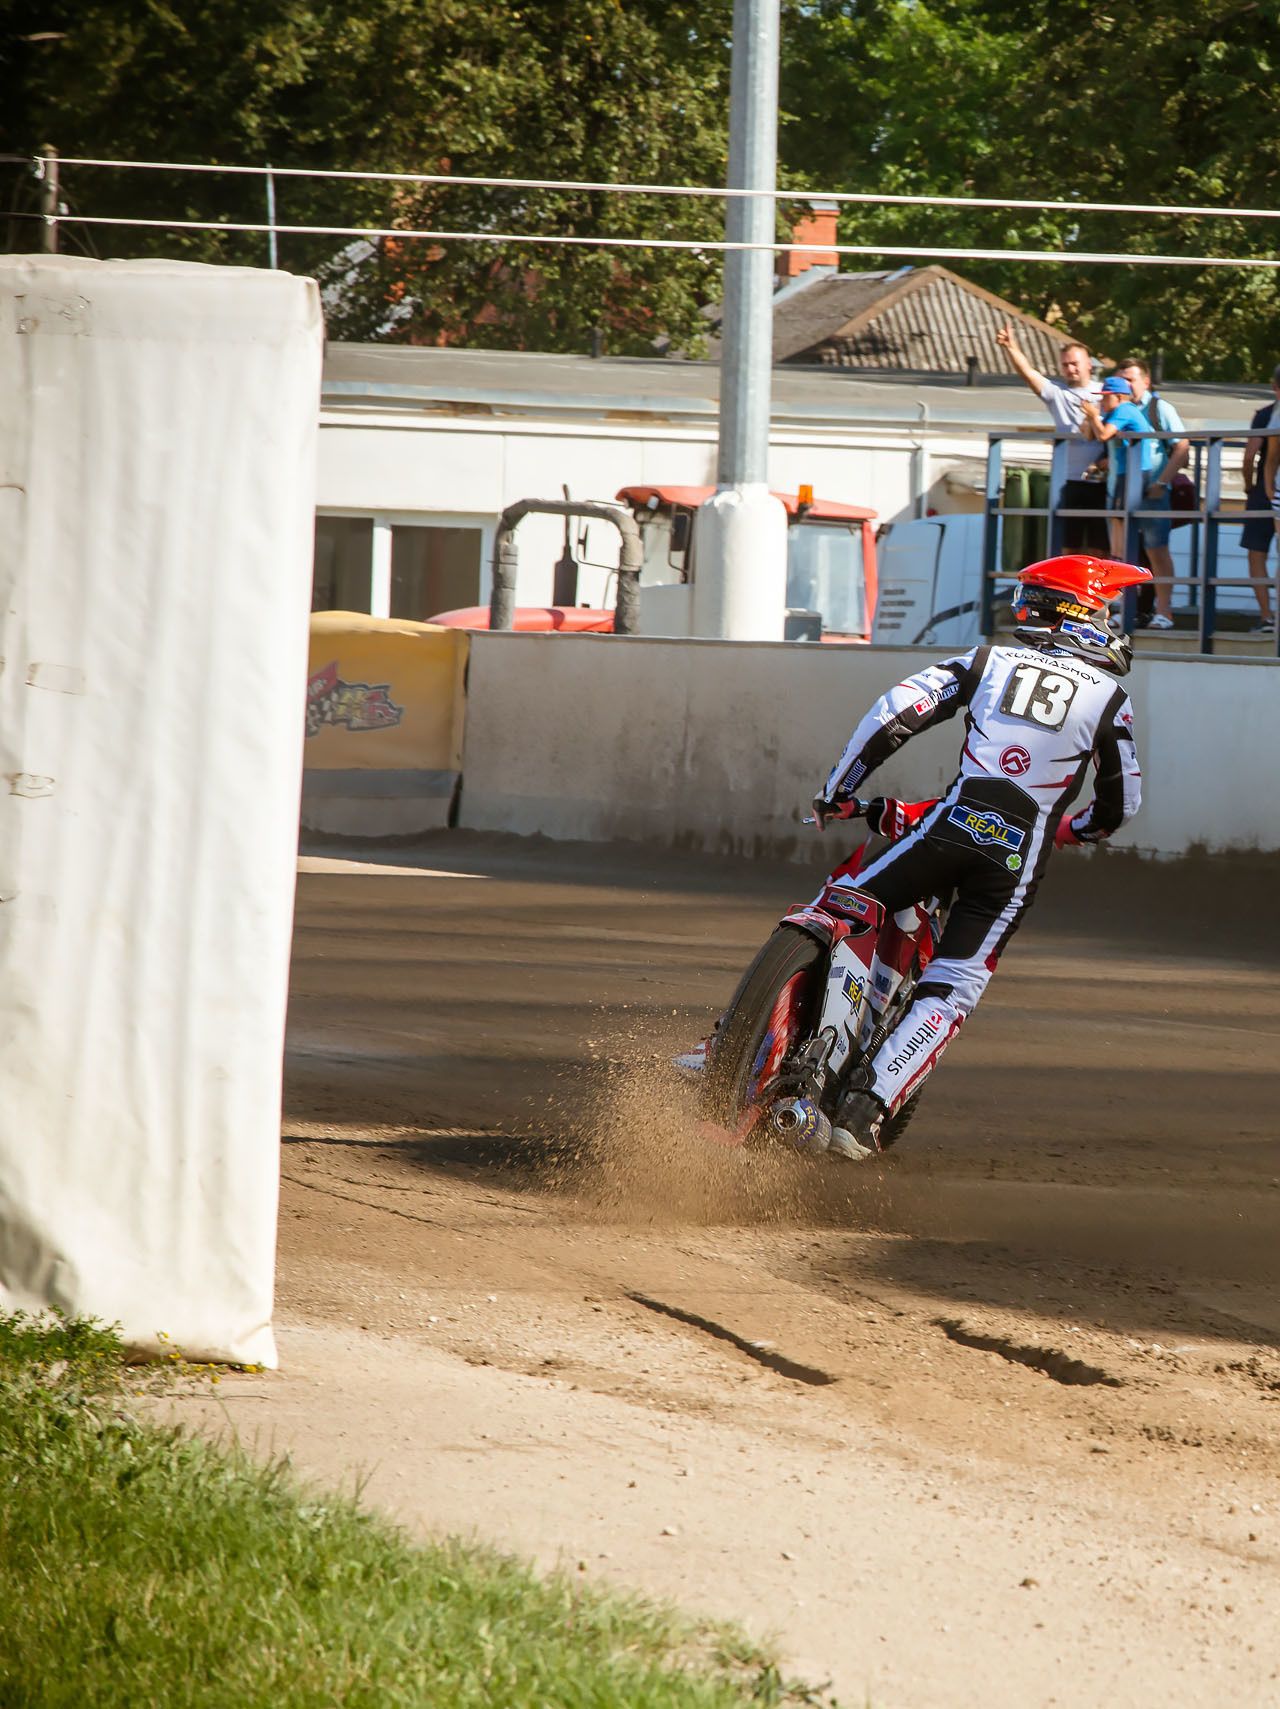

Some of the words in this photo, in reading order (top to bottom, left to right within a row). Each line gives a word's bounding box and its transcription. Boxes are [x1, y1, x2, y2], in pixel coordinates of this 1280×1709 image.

[1009, 666, 1074, 726] 13
[965, 814, 1009, 842] REALL
[799, 1106, 816, 1141] REALL
